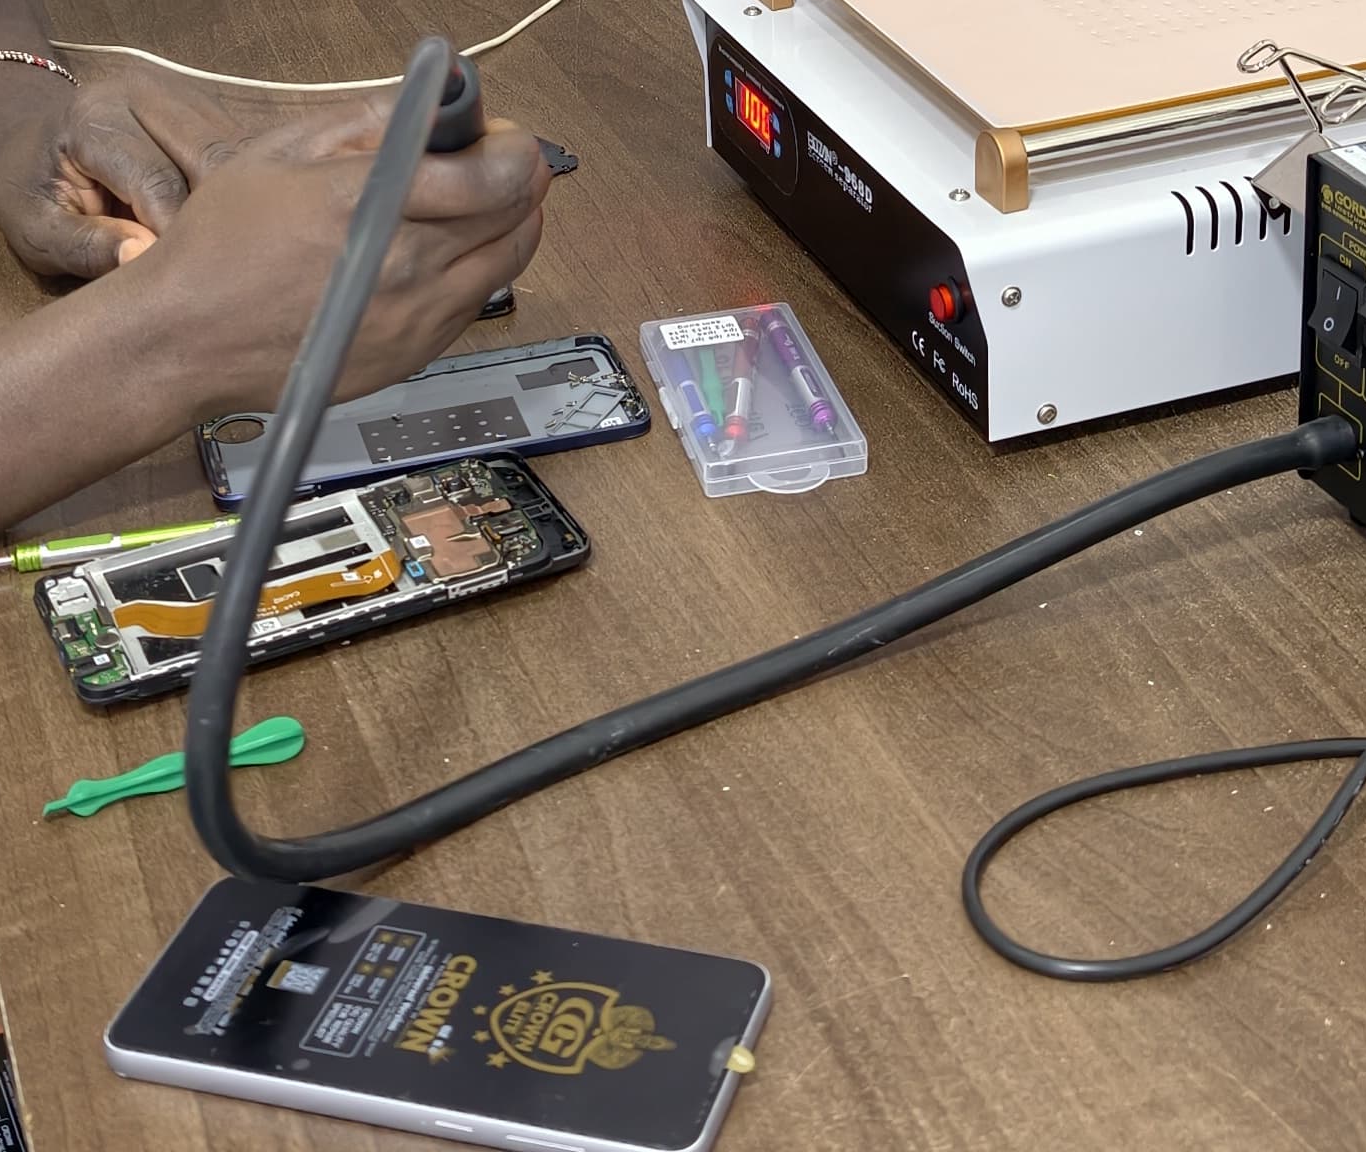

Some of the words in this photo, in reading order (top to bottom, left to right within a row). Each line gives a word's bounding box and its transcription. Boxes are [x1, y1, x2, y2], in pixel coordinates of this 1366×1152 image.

[1339, 253, 1352, 269] ON
[954, 336, 977, 368] Switch
[1334, 353, 1350, 370] OFF
[952, 371, 979, 411] RoHS
[400, 954, 478, 1054] CROWN
[502, 999, 532, 1036] ELITE
[514, 991, 560, 1053] CROWN
